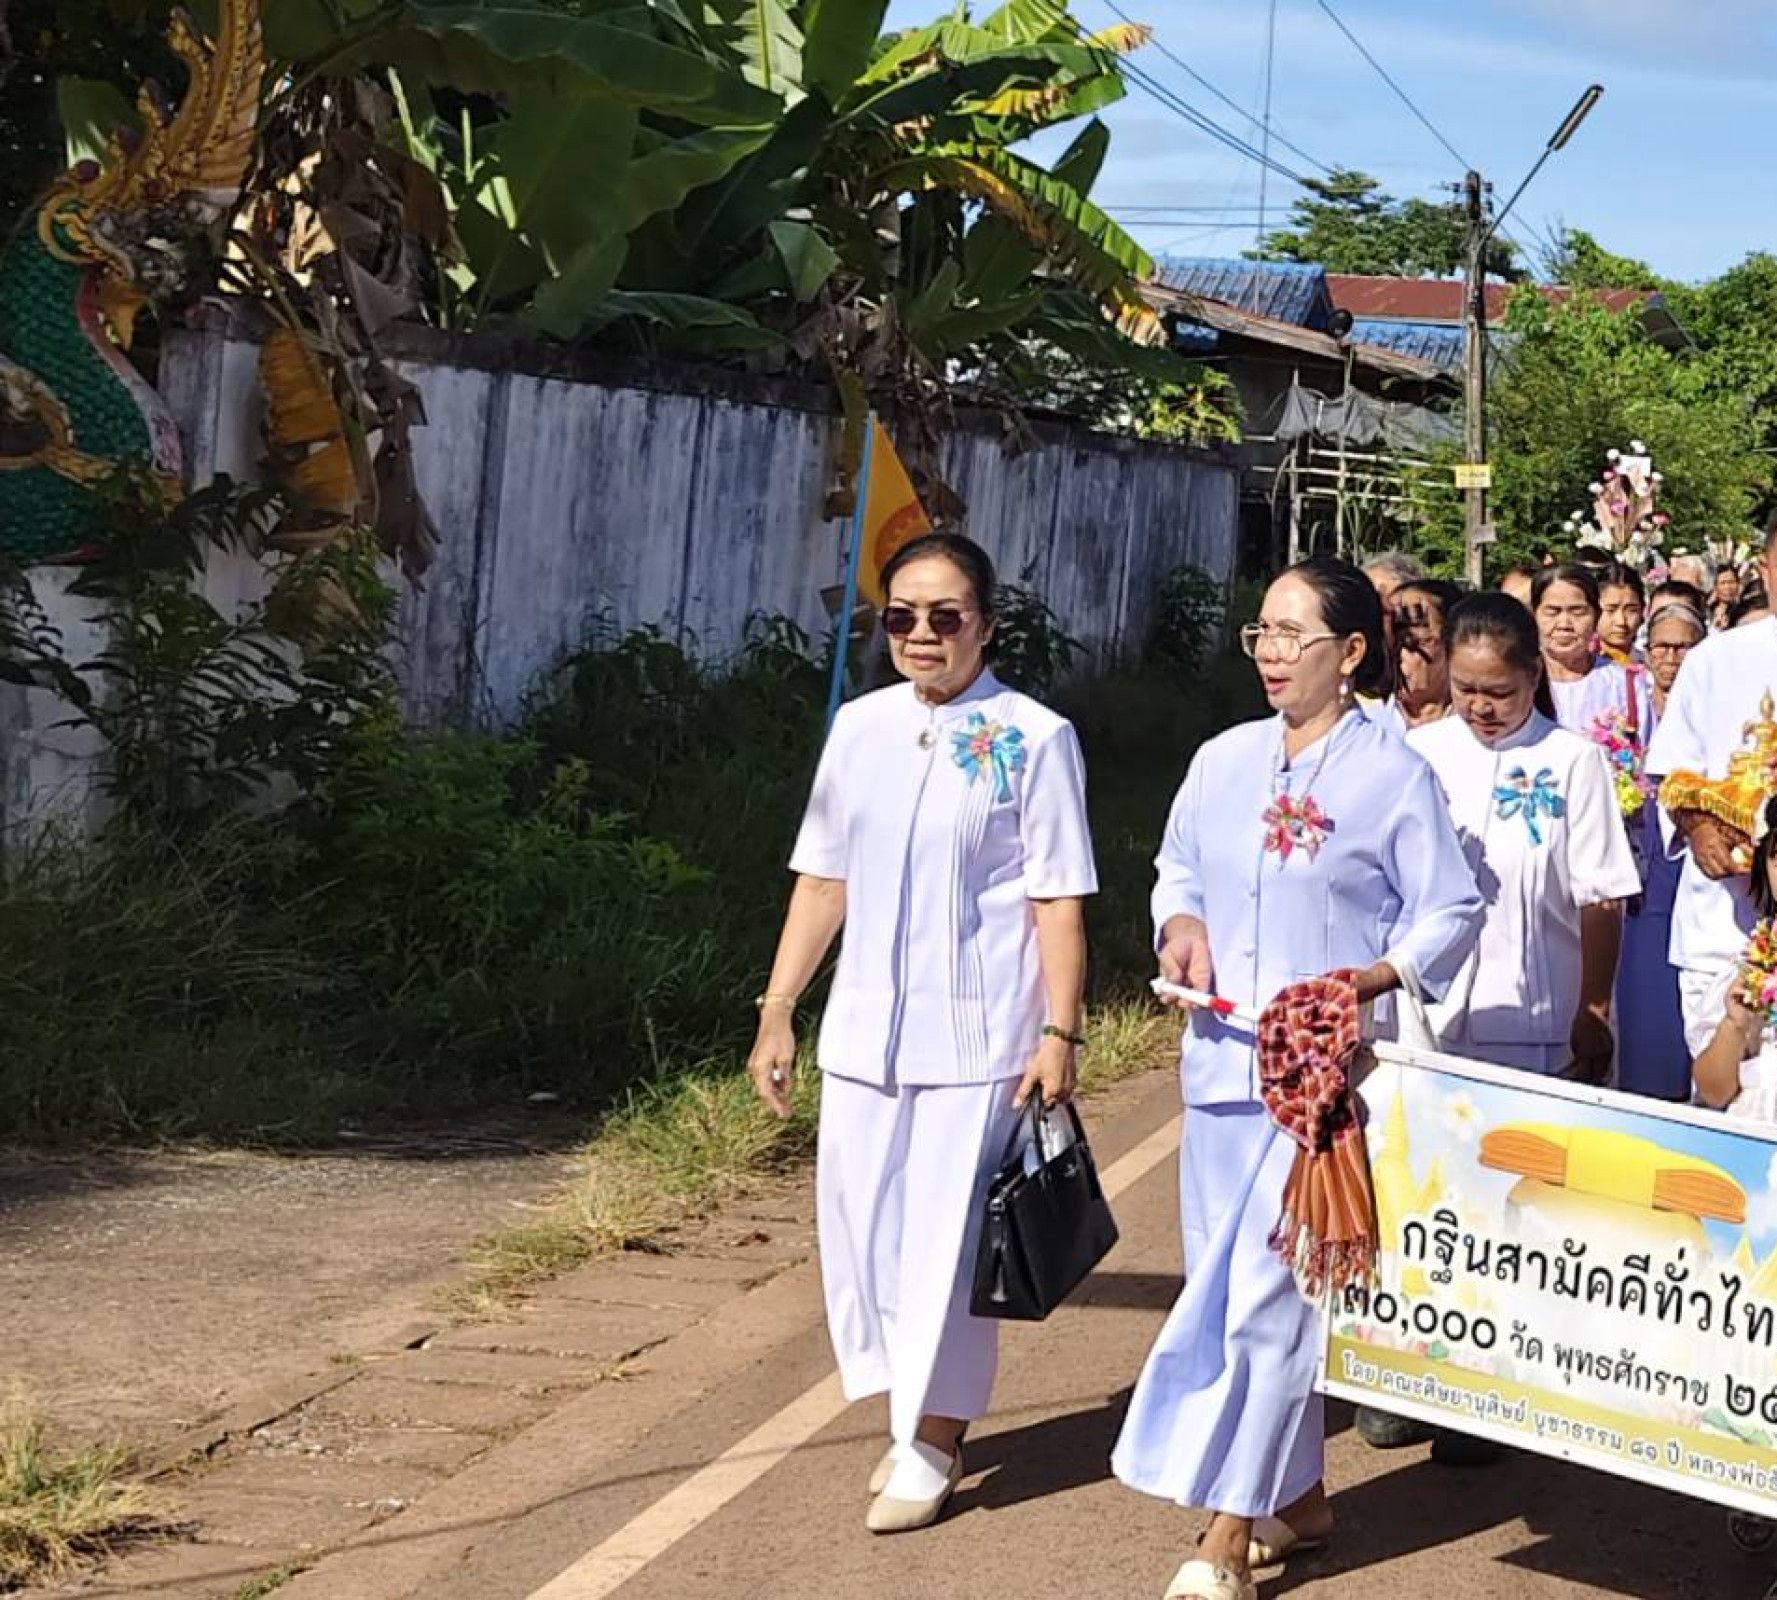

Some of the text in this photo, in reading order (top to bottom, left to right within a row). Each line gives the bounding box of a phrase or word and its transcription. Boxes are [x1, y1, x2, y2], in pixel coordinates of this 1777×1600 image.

[1342, 1351, 1376, 1382] โดย
[1666, 1438, 1681, 1466] ปี
[1509, 1319, 1545, 1363] วัด
[1553, 1342, 1710, 1406] พุทธศักราช
